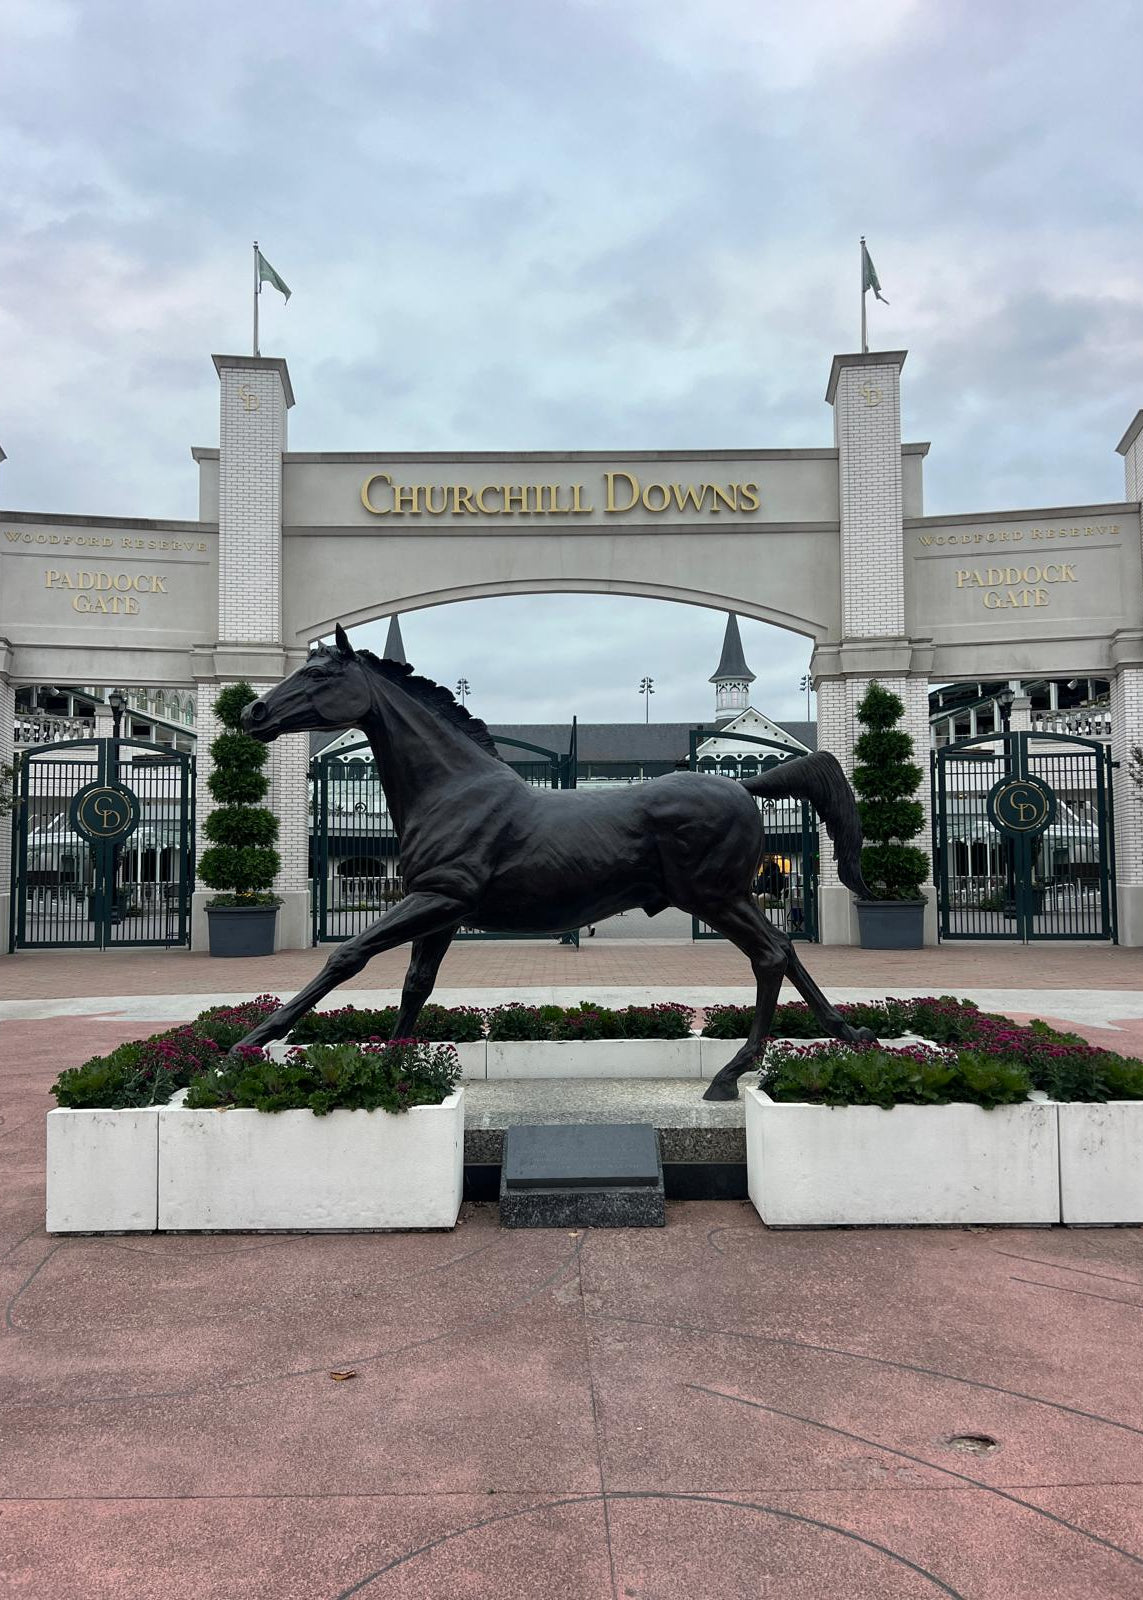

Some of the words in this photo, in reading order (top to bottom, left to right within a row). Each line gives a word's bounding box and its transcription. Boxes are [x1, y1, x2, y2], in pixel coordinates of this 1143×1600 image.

[361, 472, 593, 514] CHURCHILL
[604, 471, 761, 513] DOWNS
[4, 531, 114, 547] WOODFORD
[121, 537, 208, 552] RESERVE
[919, 530, 1024, 547] WOODFORD
[1031, 525, 1121, 540] RESERVE
[44, 570, 168, 593] PADDOCK
[955, 564, 1078, 588] PADDOCK
[71, 594, 141, 615] GATE
[983, 587, 1049, 609] GATE
